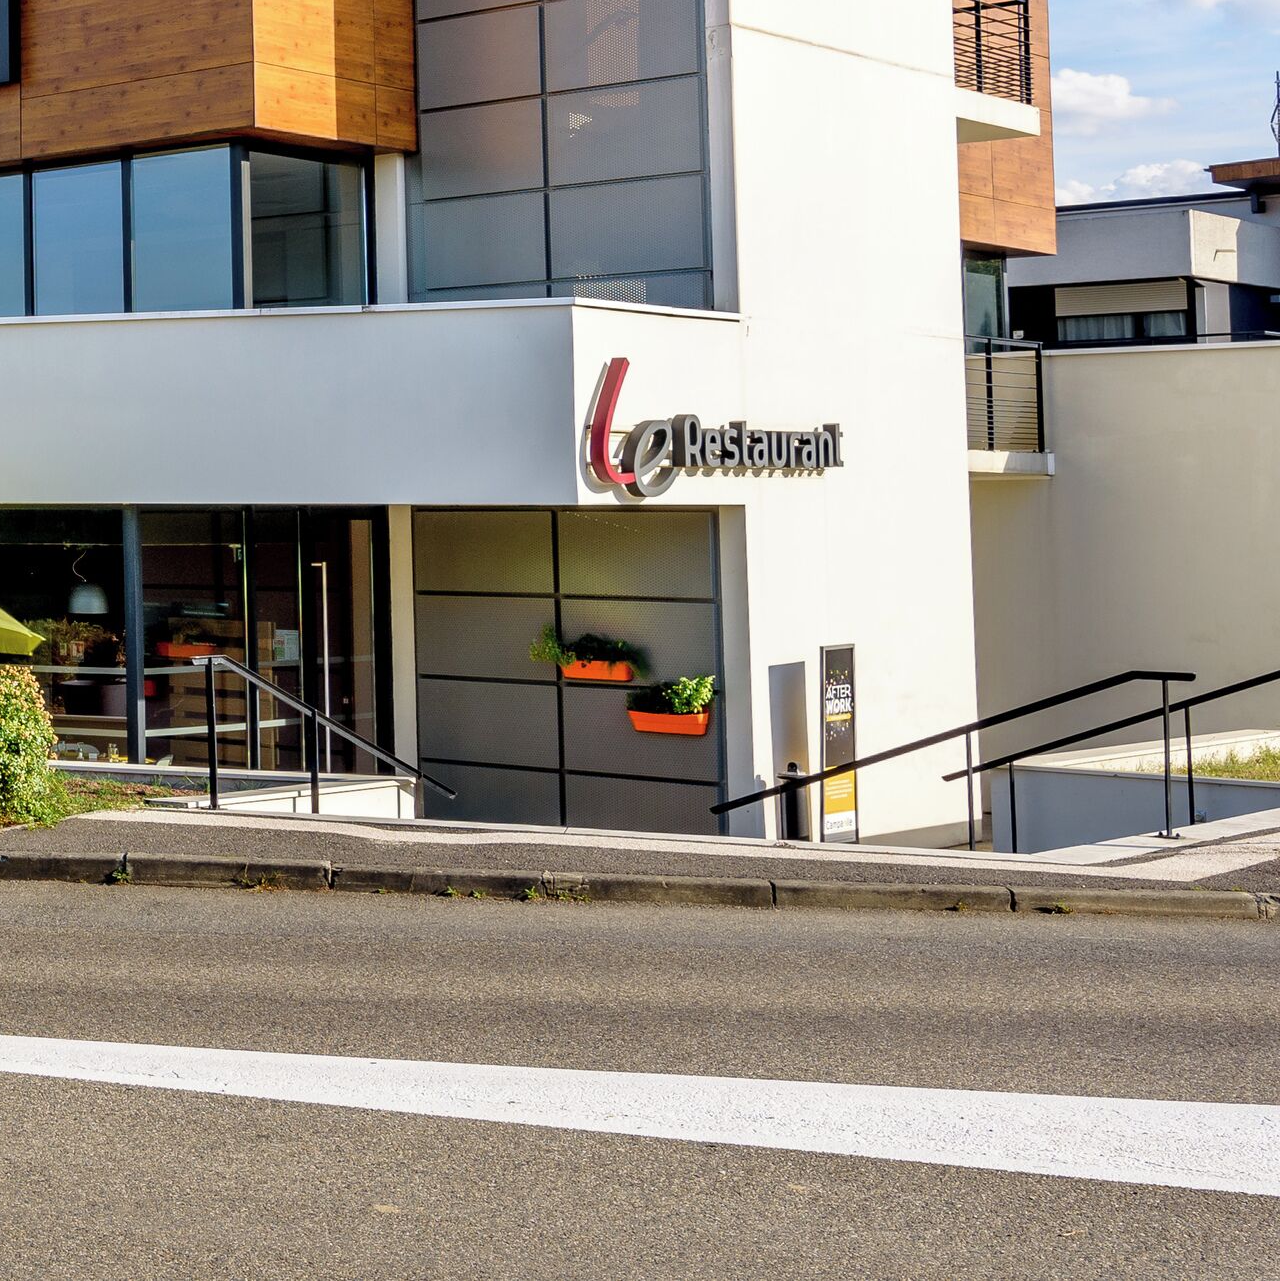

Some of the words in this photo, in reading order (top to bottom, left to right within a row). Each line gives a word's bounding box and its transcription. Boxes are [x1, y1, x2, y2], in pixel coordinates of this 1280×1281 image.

[672, 414, 841, 468] Restaurant
[826, 684, 851, 699] AFTER
[826, 698, 852, 715] WORK
